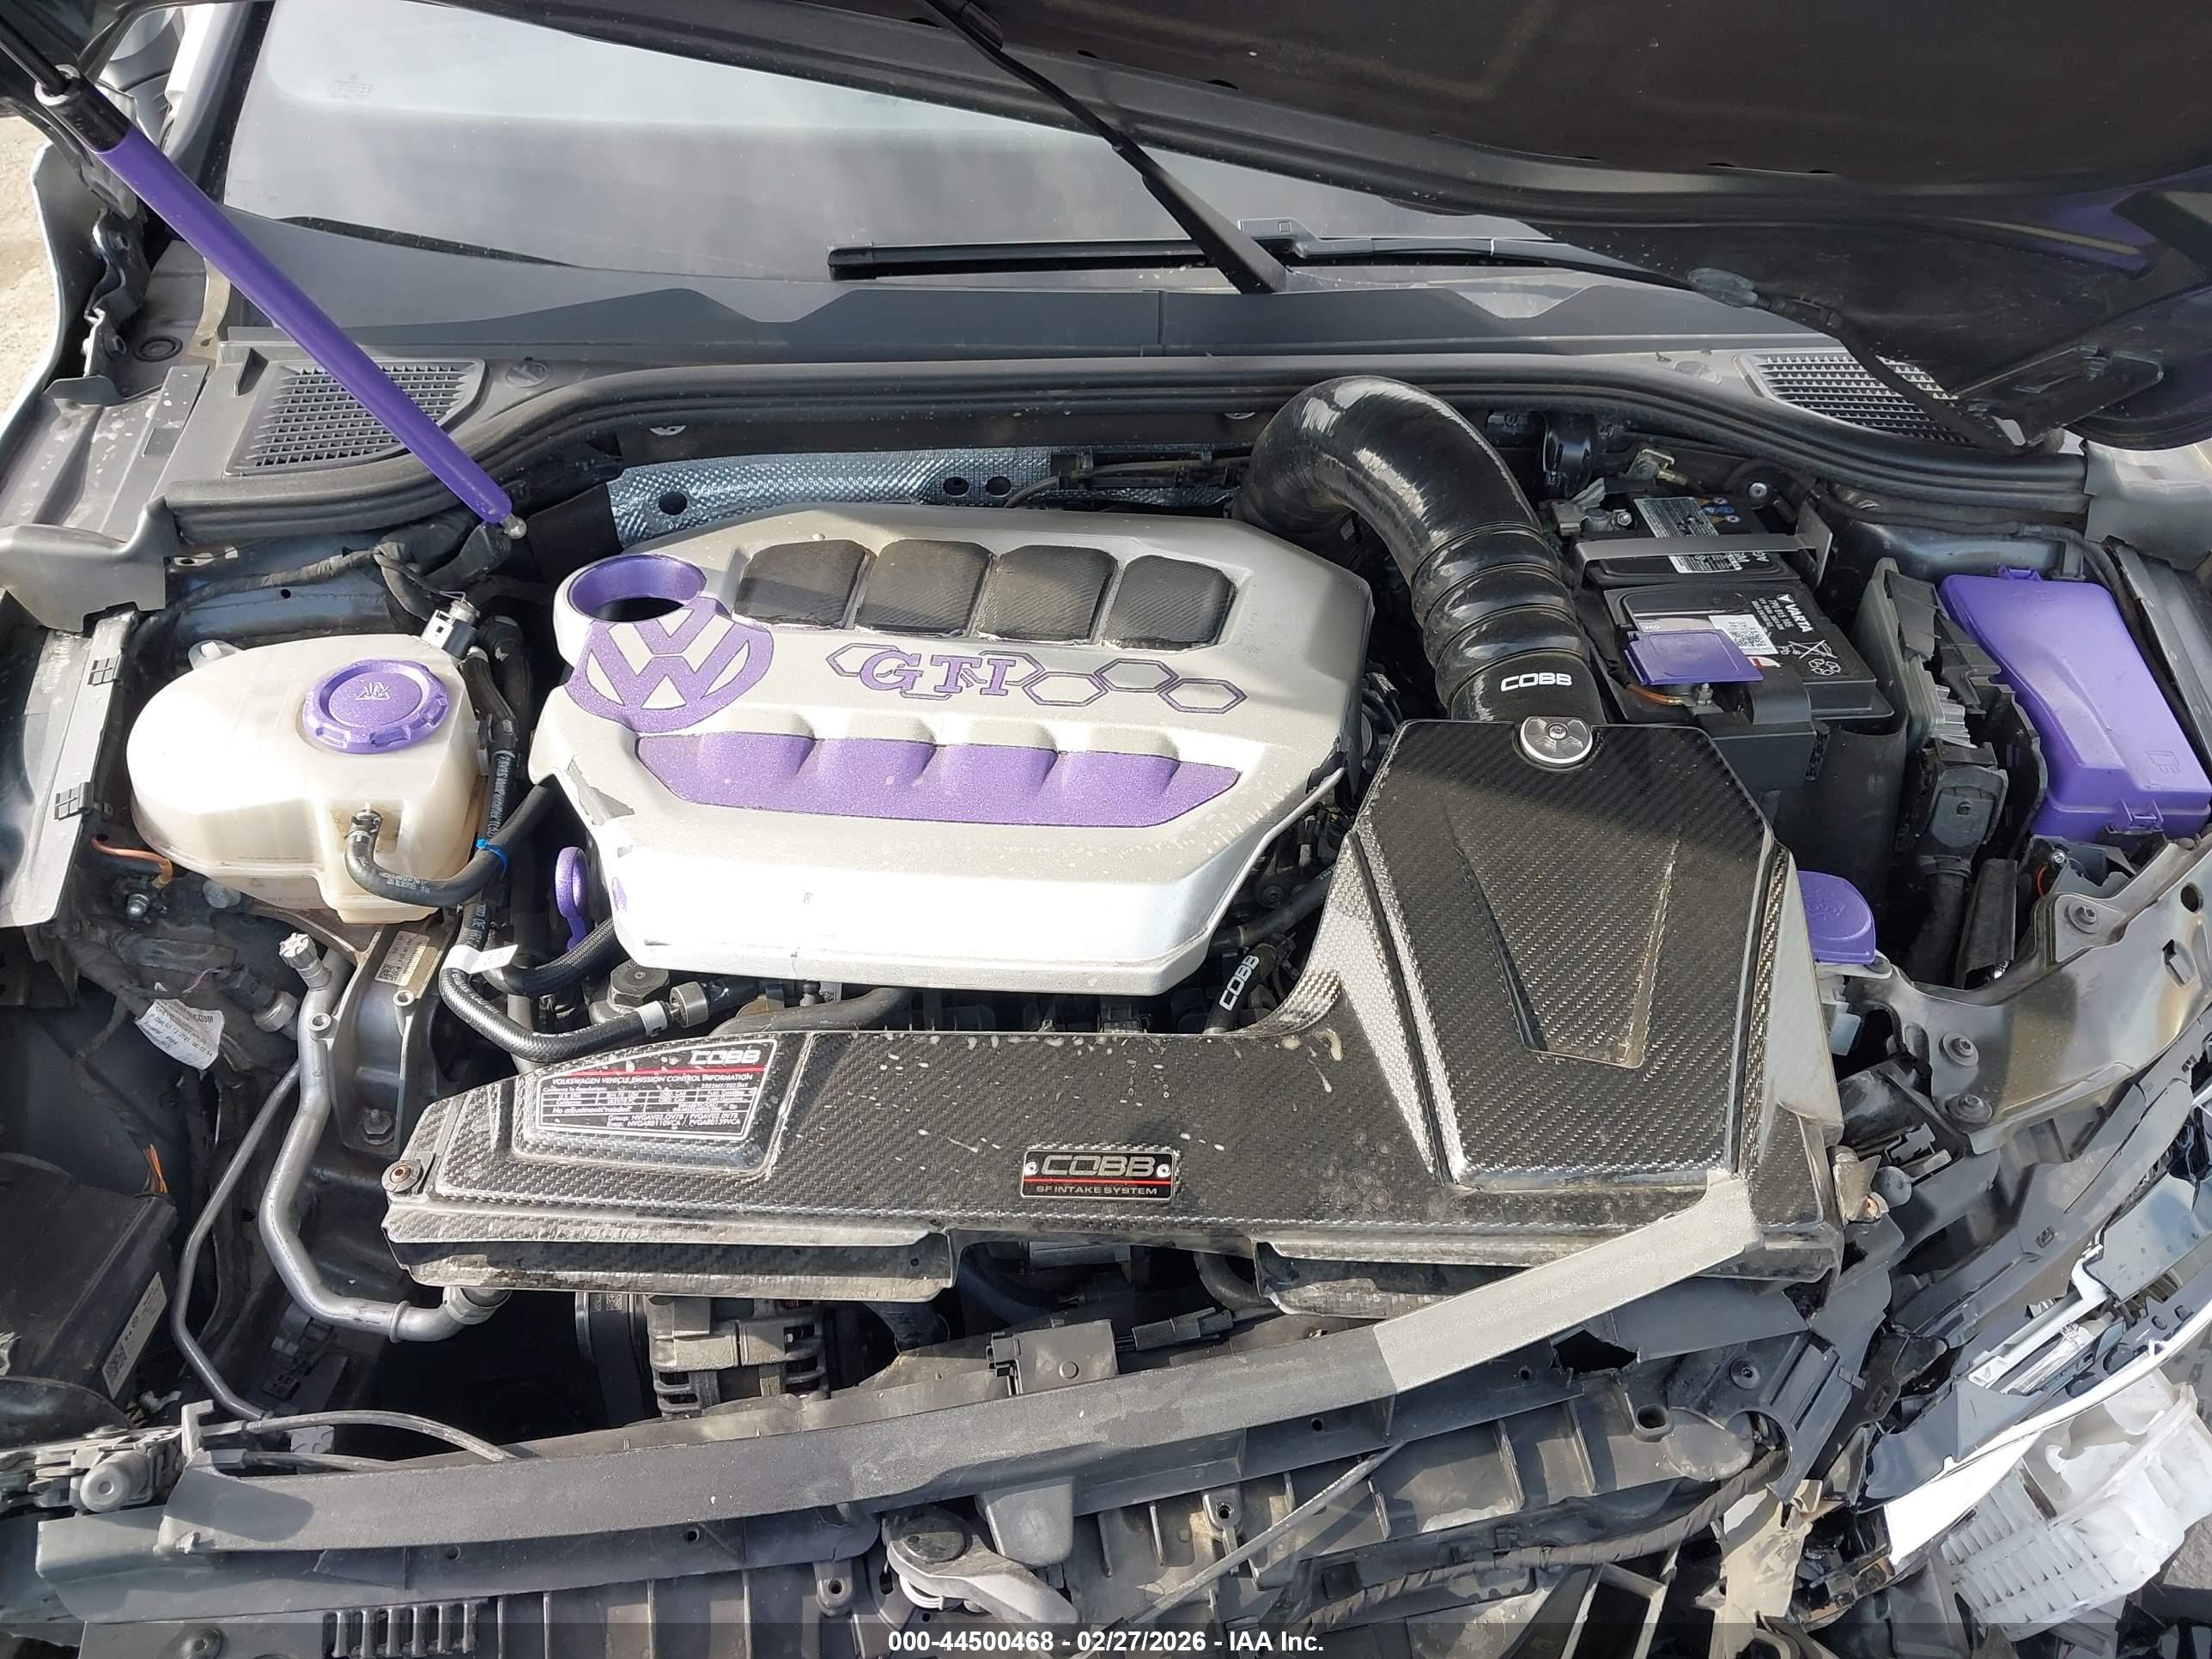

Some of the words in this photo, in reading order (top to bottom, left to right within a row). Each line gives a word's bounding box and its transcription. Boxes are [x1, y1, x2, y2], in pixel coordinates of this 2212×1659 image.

[1775, 609, 1787, 618] 915
[1785, 604, 1814, 632] VARTA
[1777, 646, 1790, 655] Pb
[859, 650, 1016, 696] GTI
[1500, 672, 1572, 691] COBB
[1219, 955, 1260, 1011] COBB
[690, 1050, 762, 1065] COBB
[552, 1077, 601, 1085] VOLKSWAGEN
[631, 1075, 665, 1084] EMISSION
[702, 1073, 753, 1082] INFORMATION
[564, 1106, 603, 1115] adjustments
[1041, 1154, 1156, 1177] COBB
[1054, 1185, 1102, 1194] INTAKE
